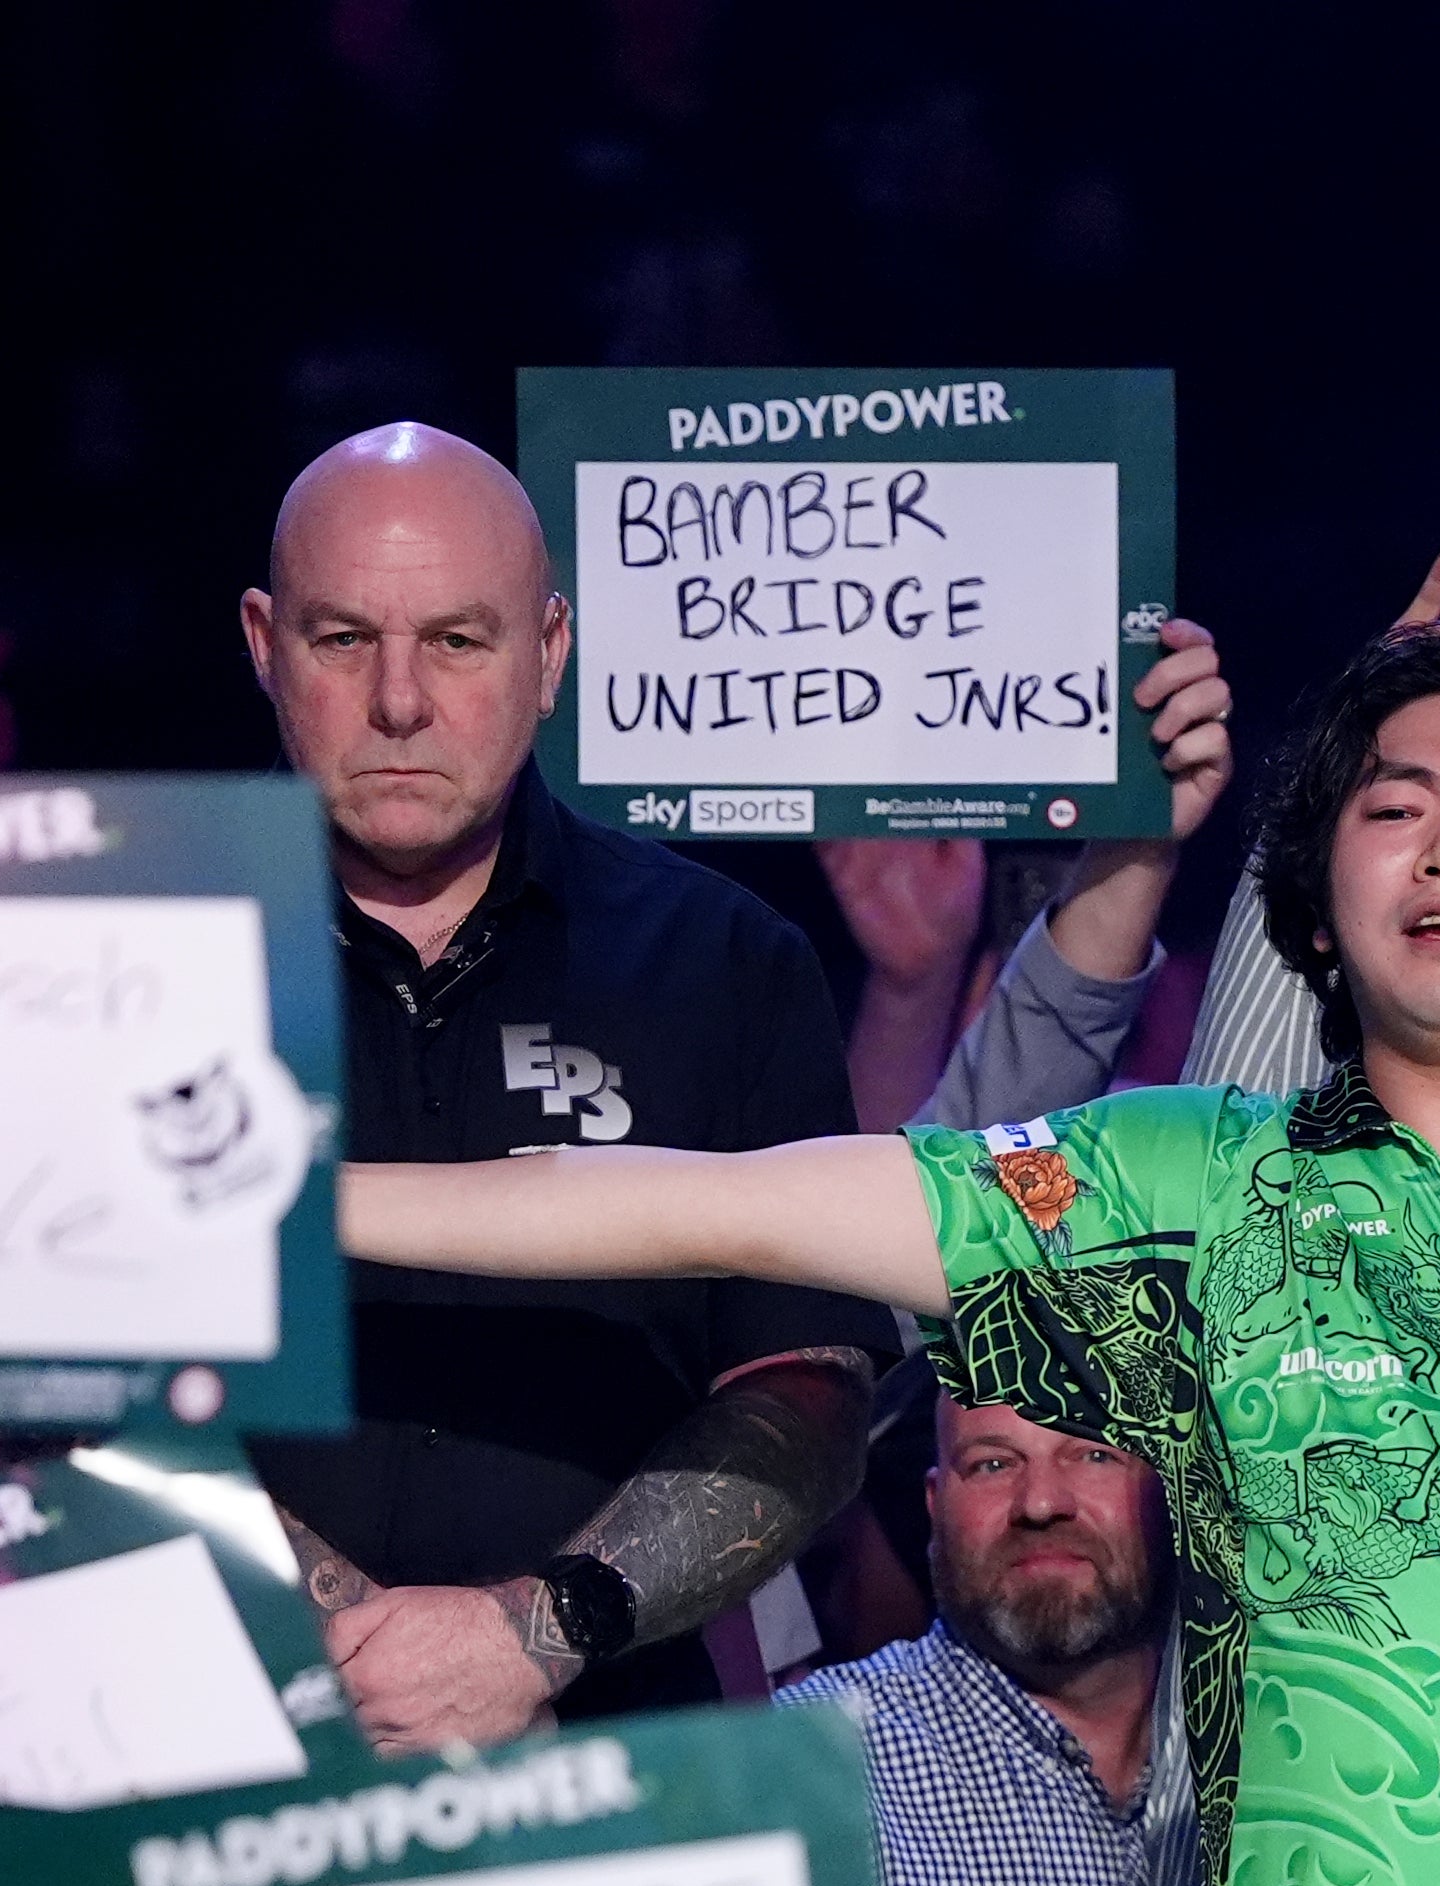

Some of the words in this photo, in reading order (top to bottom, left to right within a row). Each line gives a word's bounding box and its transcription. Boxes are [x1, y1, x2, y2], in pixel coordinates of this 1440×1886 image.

[617, 469, 948, 568] BAMBER
[677, 575, 987, 641] BRIDGE
[606, 667, 883, 735] UNITED
[914, 660, 1112, 735] JNRS!
[626, 792, 688, 829] sky
[698, 793, 806, 827] sports
[395, 983, 418, 1015] EPS
[500, 1022, 634, 1143] EPS
